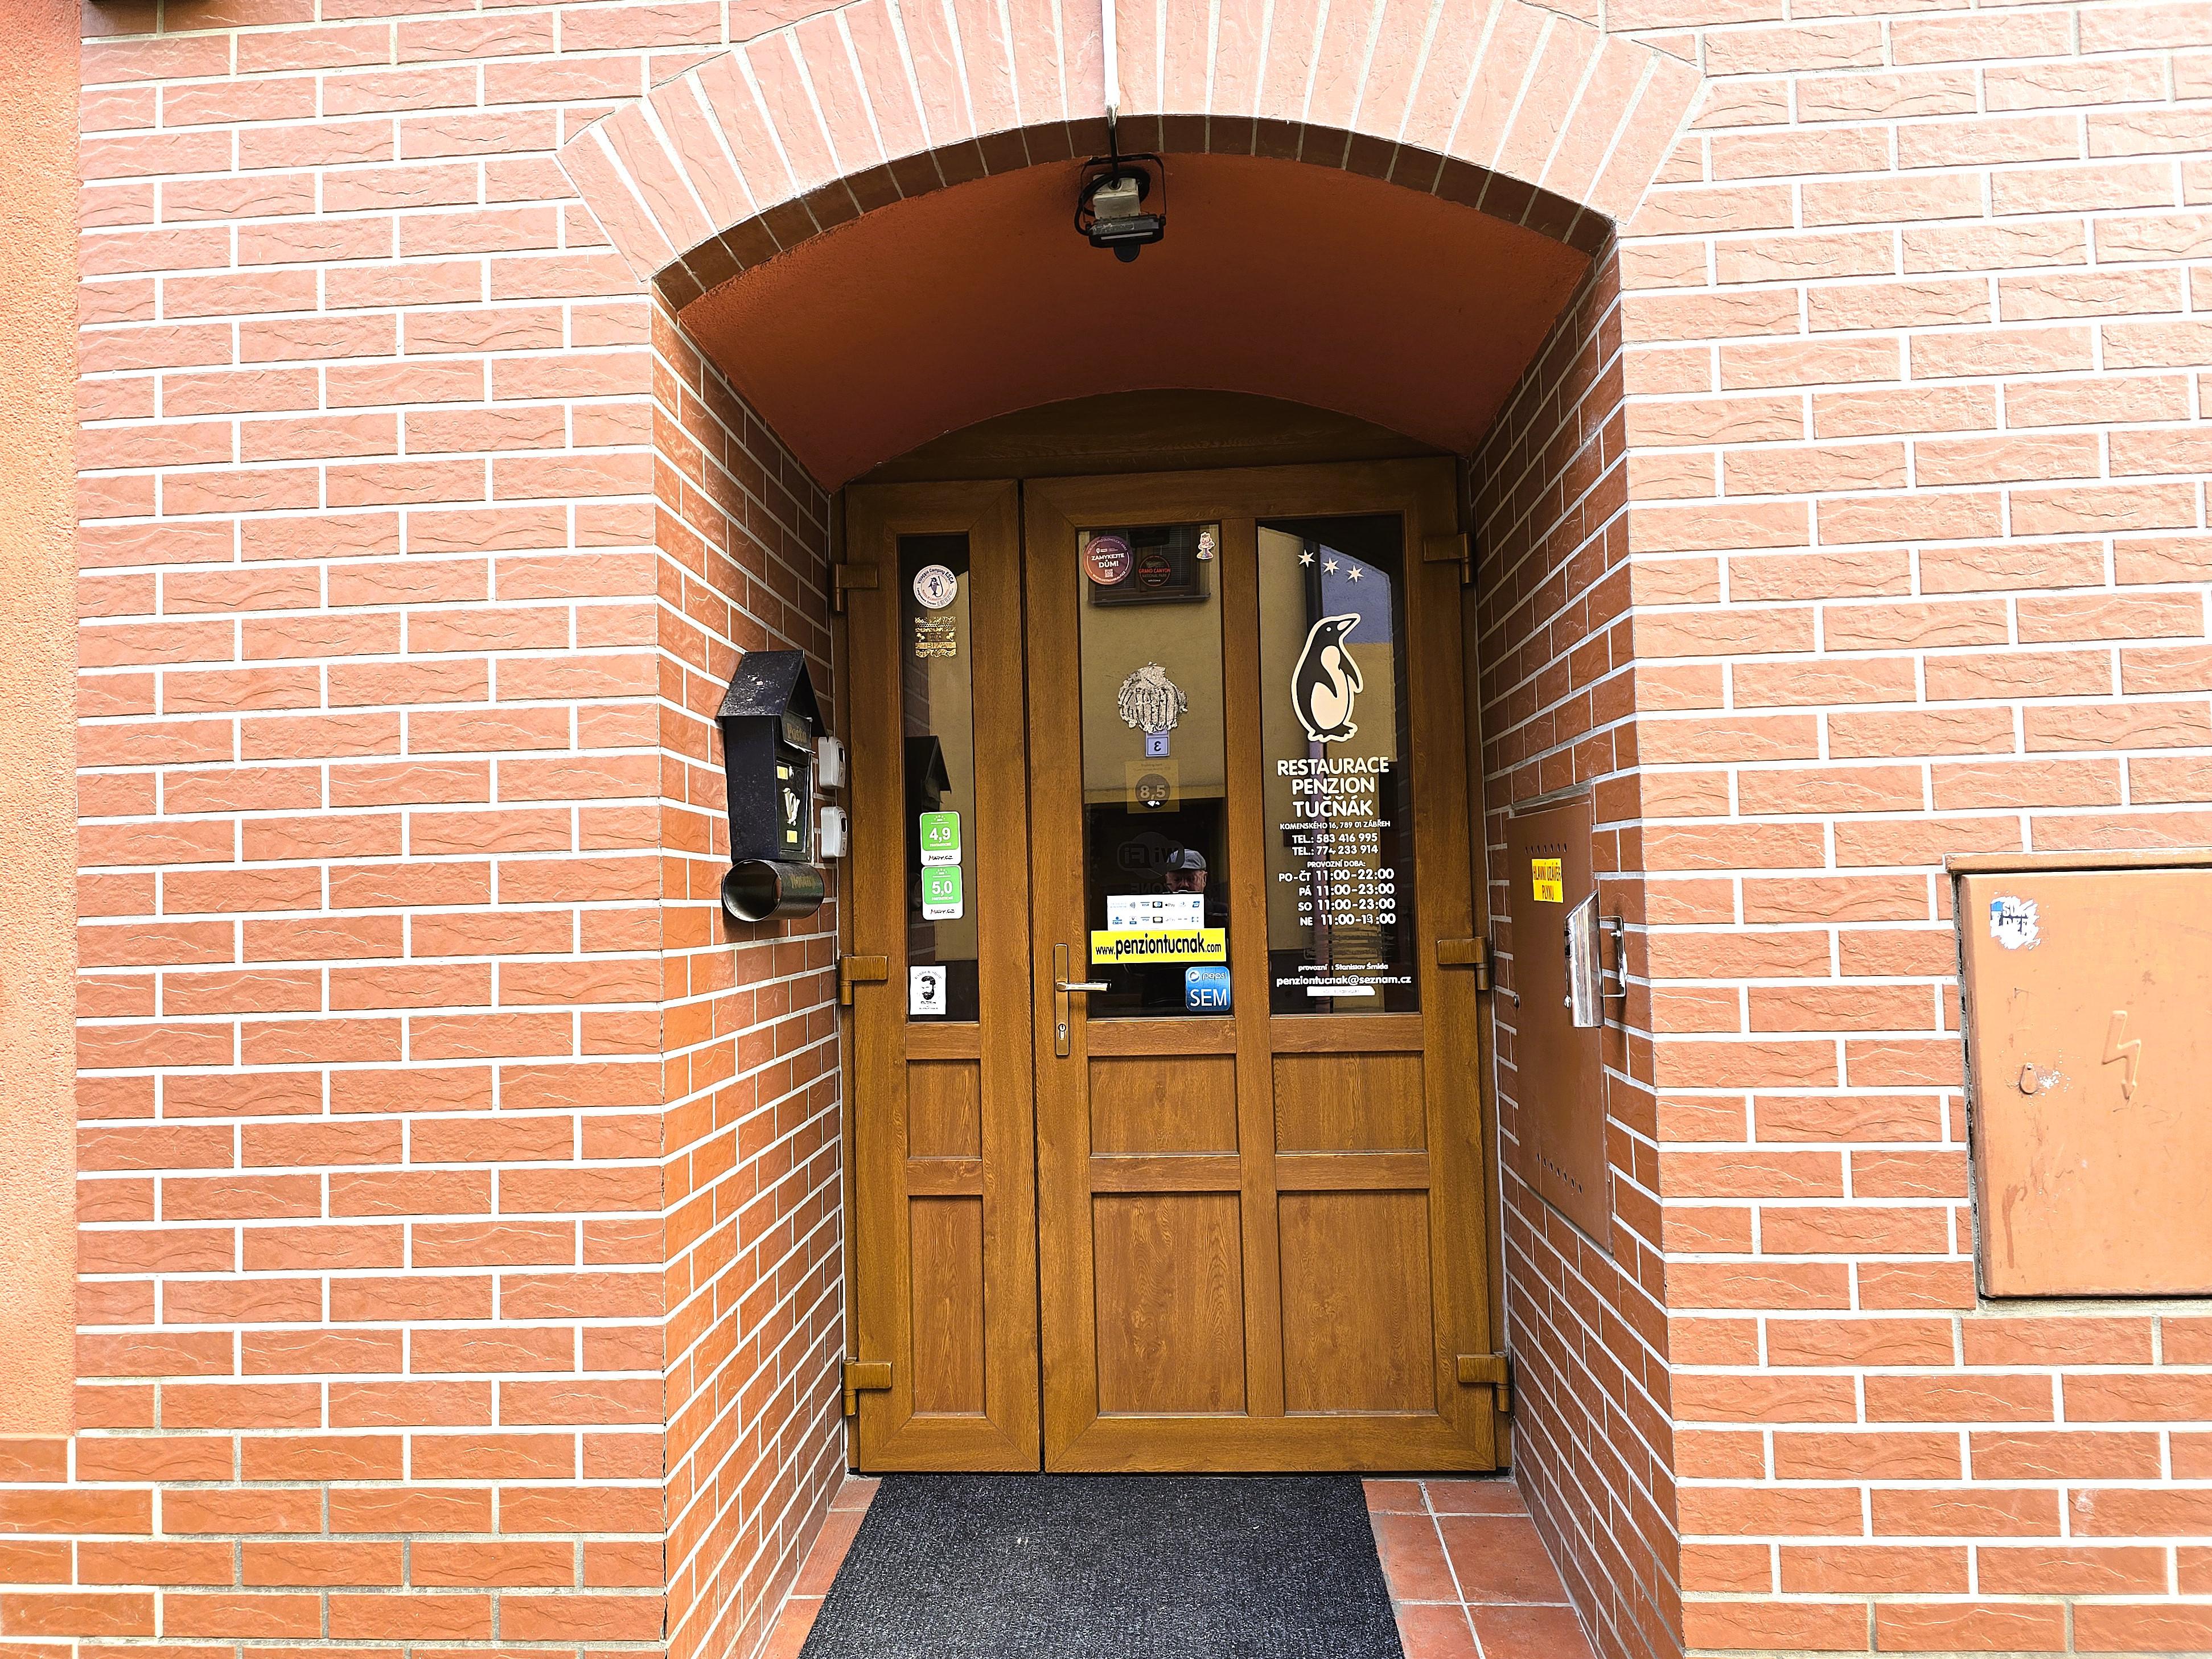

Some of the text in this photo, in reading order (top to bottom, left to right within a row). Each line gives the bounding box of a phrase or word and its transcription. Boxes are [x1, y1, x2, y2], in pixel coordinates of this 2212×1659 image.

[945, 571, 955, 584] ESCA
[1277, 756, 1389, 776] RESTAURACE
[1292, 776, 1375, 795] PENZION
[1140, 785, 1166, 800] 8,5
[1292, 795, 1374, 818] TUČŇÁK
[1280, 821, 1328, 830] KOMENSKÉHO
[1363, 820, 1391, 828] ZÁBŘEH
[929, 827, 951, 843] 4,9
[1292, 833, 1378, 843] TEL.: 583 416 995
[1292, 845, 1379, 855] TEL.: 774 233 914
[1307, 859, 1343, 868] PROVOZNÍ
[1278, 868, 1395, 882] PO-ČT 11:00-22:00
[932, 880, 953, 897] 5,0
[1298, 883, 1395, 896] PÁ 11:00-23:00
[1298, 898, 1396, 912] SO 11:00-23:00
[1300, 916, 1313, 926] NE
[1096, 932, 1222, 961] www.penziontucnak.com
[1298, 964, 1328, 972] provozní
[1202, 971, 1228, 981] pepsi
[1276, 975, 1412, 987] penziontucnak@seznam.cz
[1190, 988, 1227, 1007] SEM
